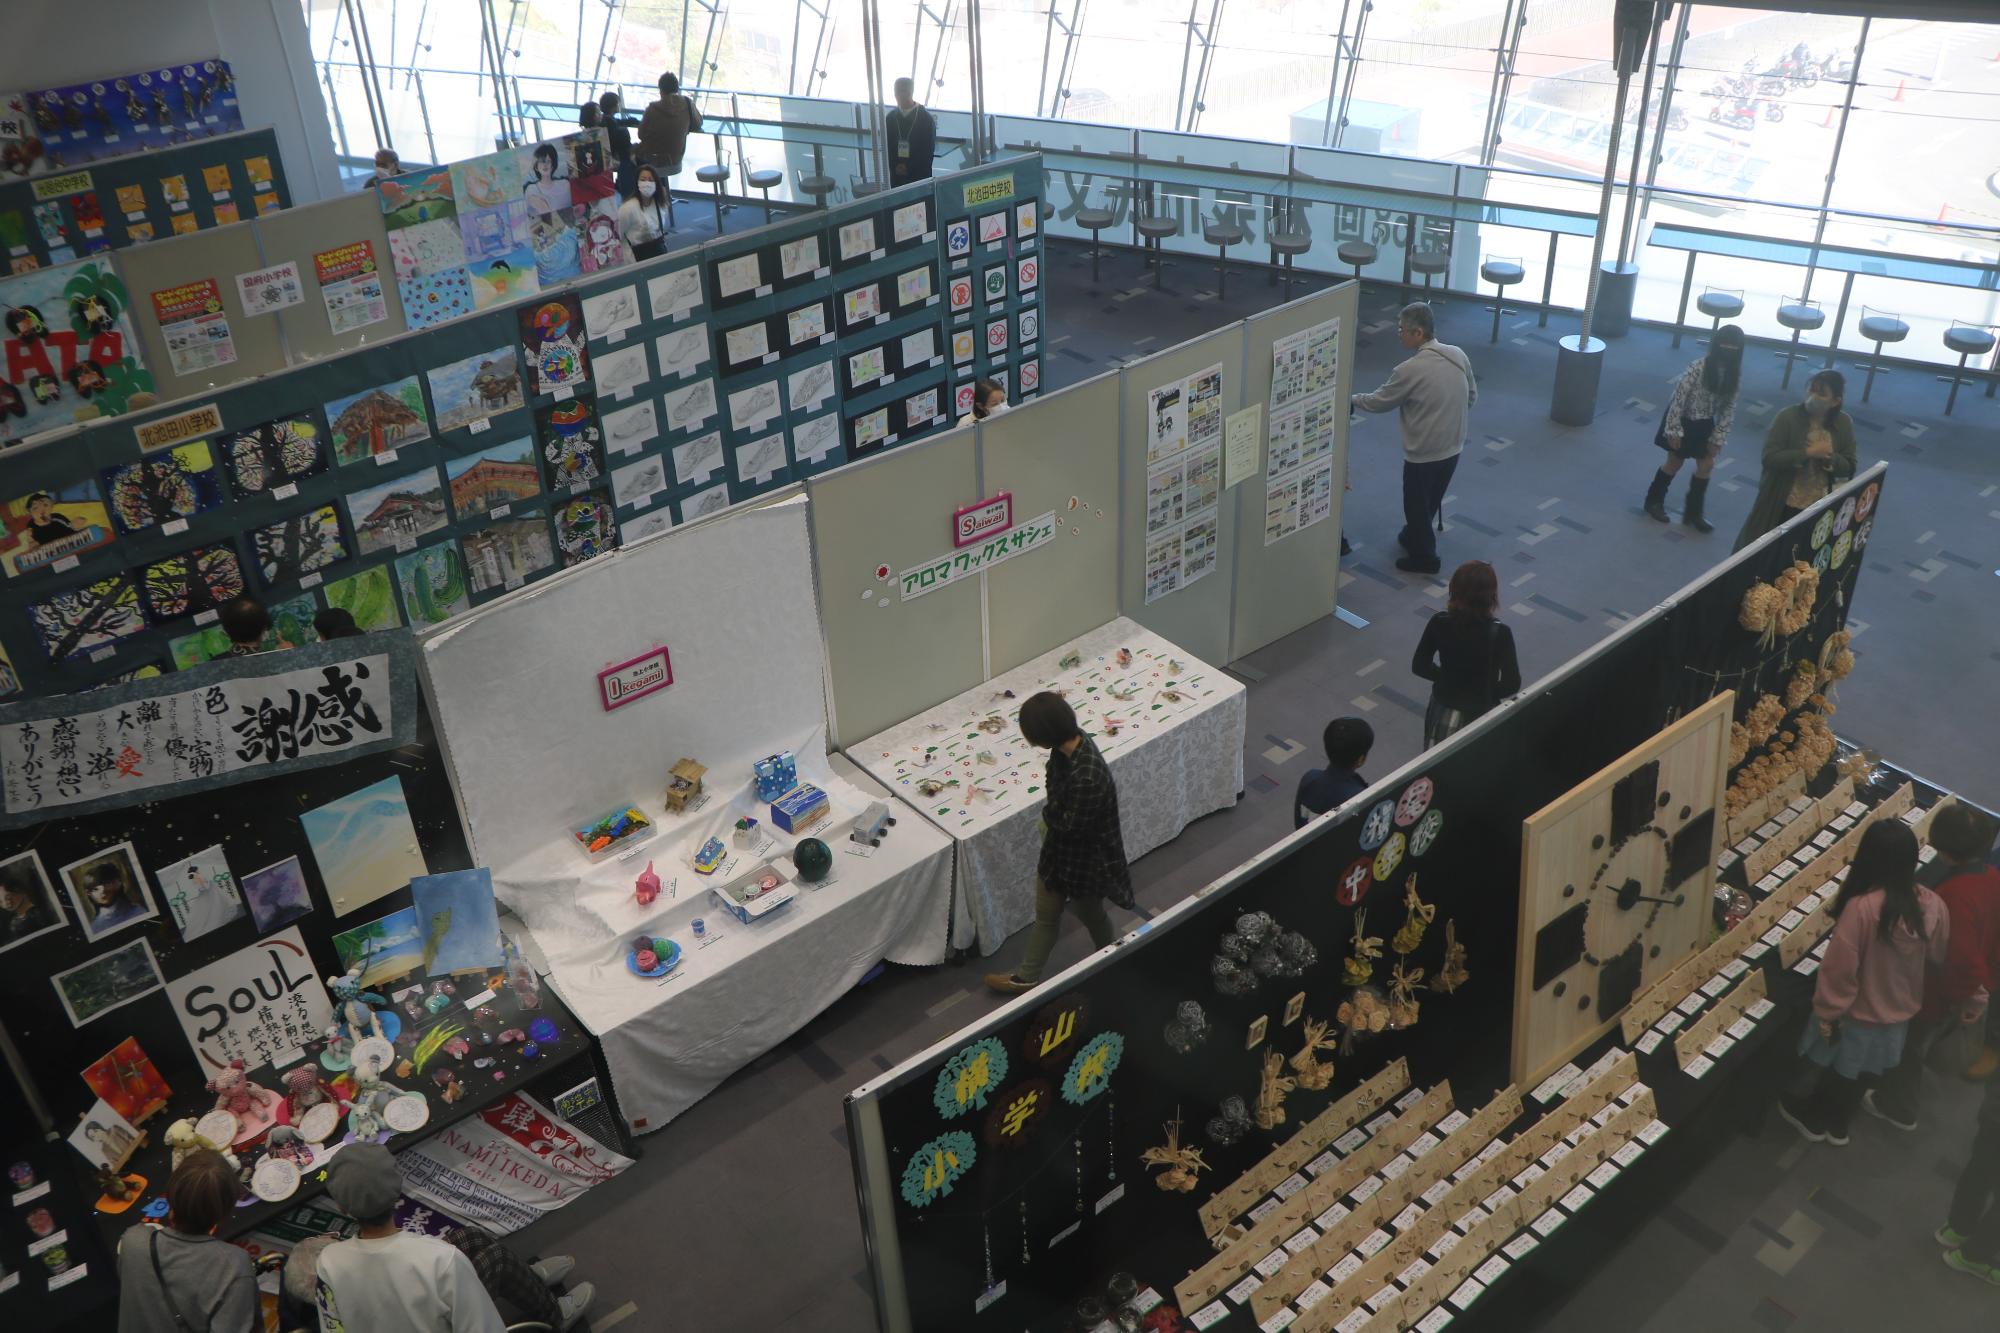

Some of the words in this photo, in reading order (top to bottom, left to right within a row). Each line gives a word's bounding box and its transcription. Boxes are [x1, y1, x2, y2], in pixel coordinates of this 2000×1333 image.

[967, 180, 1011, 204] 北池田中学校
[140, 408, 216, 448] 北池田小学校
[962, 512, 1004, 535] Saiwai
[610, 670, 663, 699] Ikegami
[231, 662, 382, 763] 感謝
[20, 723, 44, 806] ありがとう
[497, 1156, 561, 1199] IKEDA
